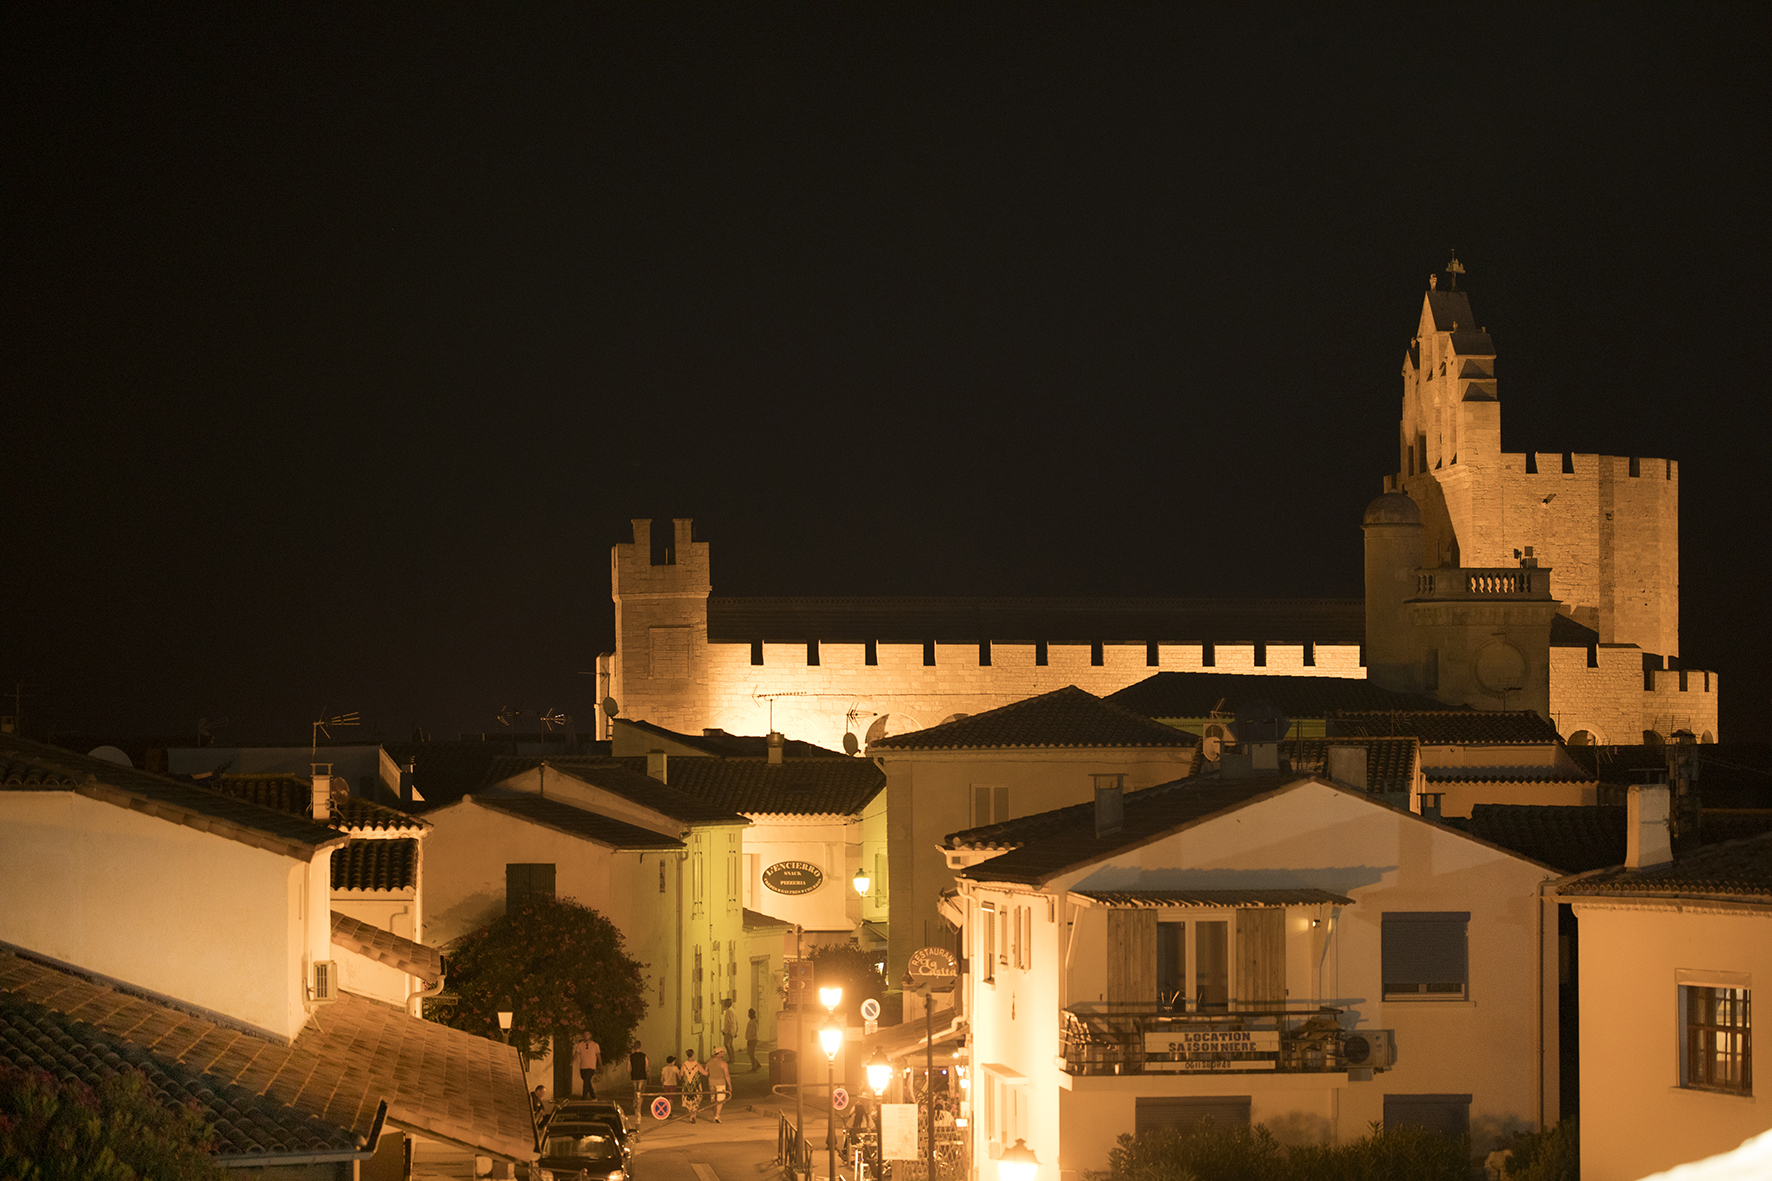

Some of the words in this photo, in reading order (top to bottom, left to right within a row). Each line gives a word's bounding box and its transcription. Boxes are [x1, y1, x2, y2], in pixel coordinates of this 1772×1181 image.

[766, 862, 821, 877] L'ENCIERRO
[911, 947, 957, 966] RESTAURANT
[919, 965, 957, 977] Casita
[1184, 1032, 1251, 1042] LOCATION
